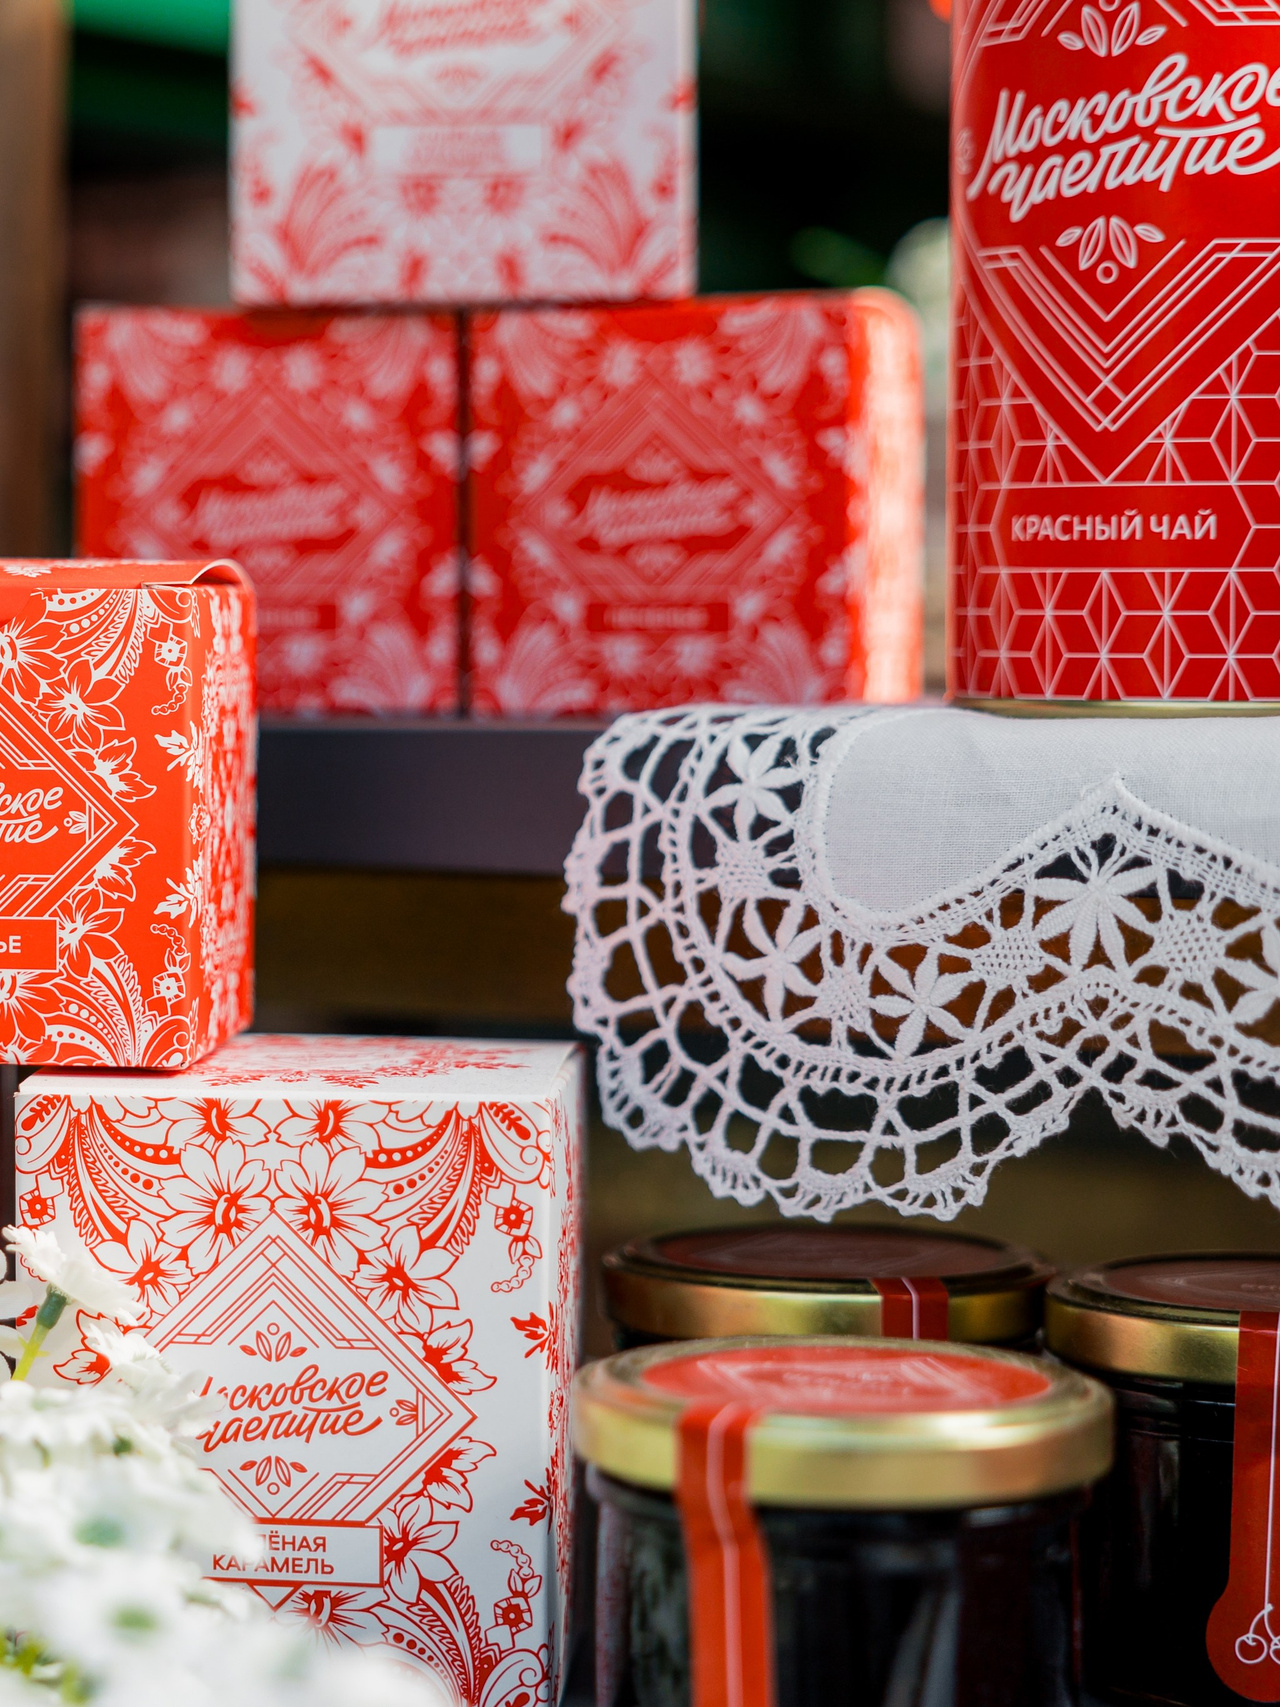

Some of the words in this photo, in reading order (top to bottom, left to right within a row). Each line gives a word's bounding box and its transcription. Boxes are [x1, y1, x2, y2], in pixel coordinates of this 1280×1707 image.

[986, 112, 1280, 223] чаепитие
[1011, 508, 1144, 541] КРАСНЫЙ
[1149, 508, 1218, 541] ЧАЙ
[199, 1363, 389, 1412] сковское
[257, 1530, 327, 1552] ЁНАЯ
